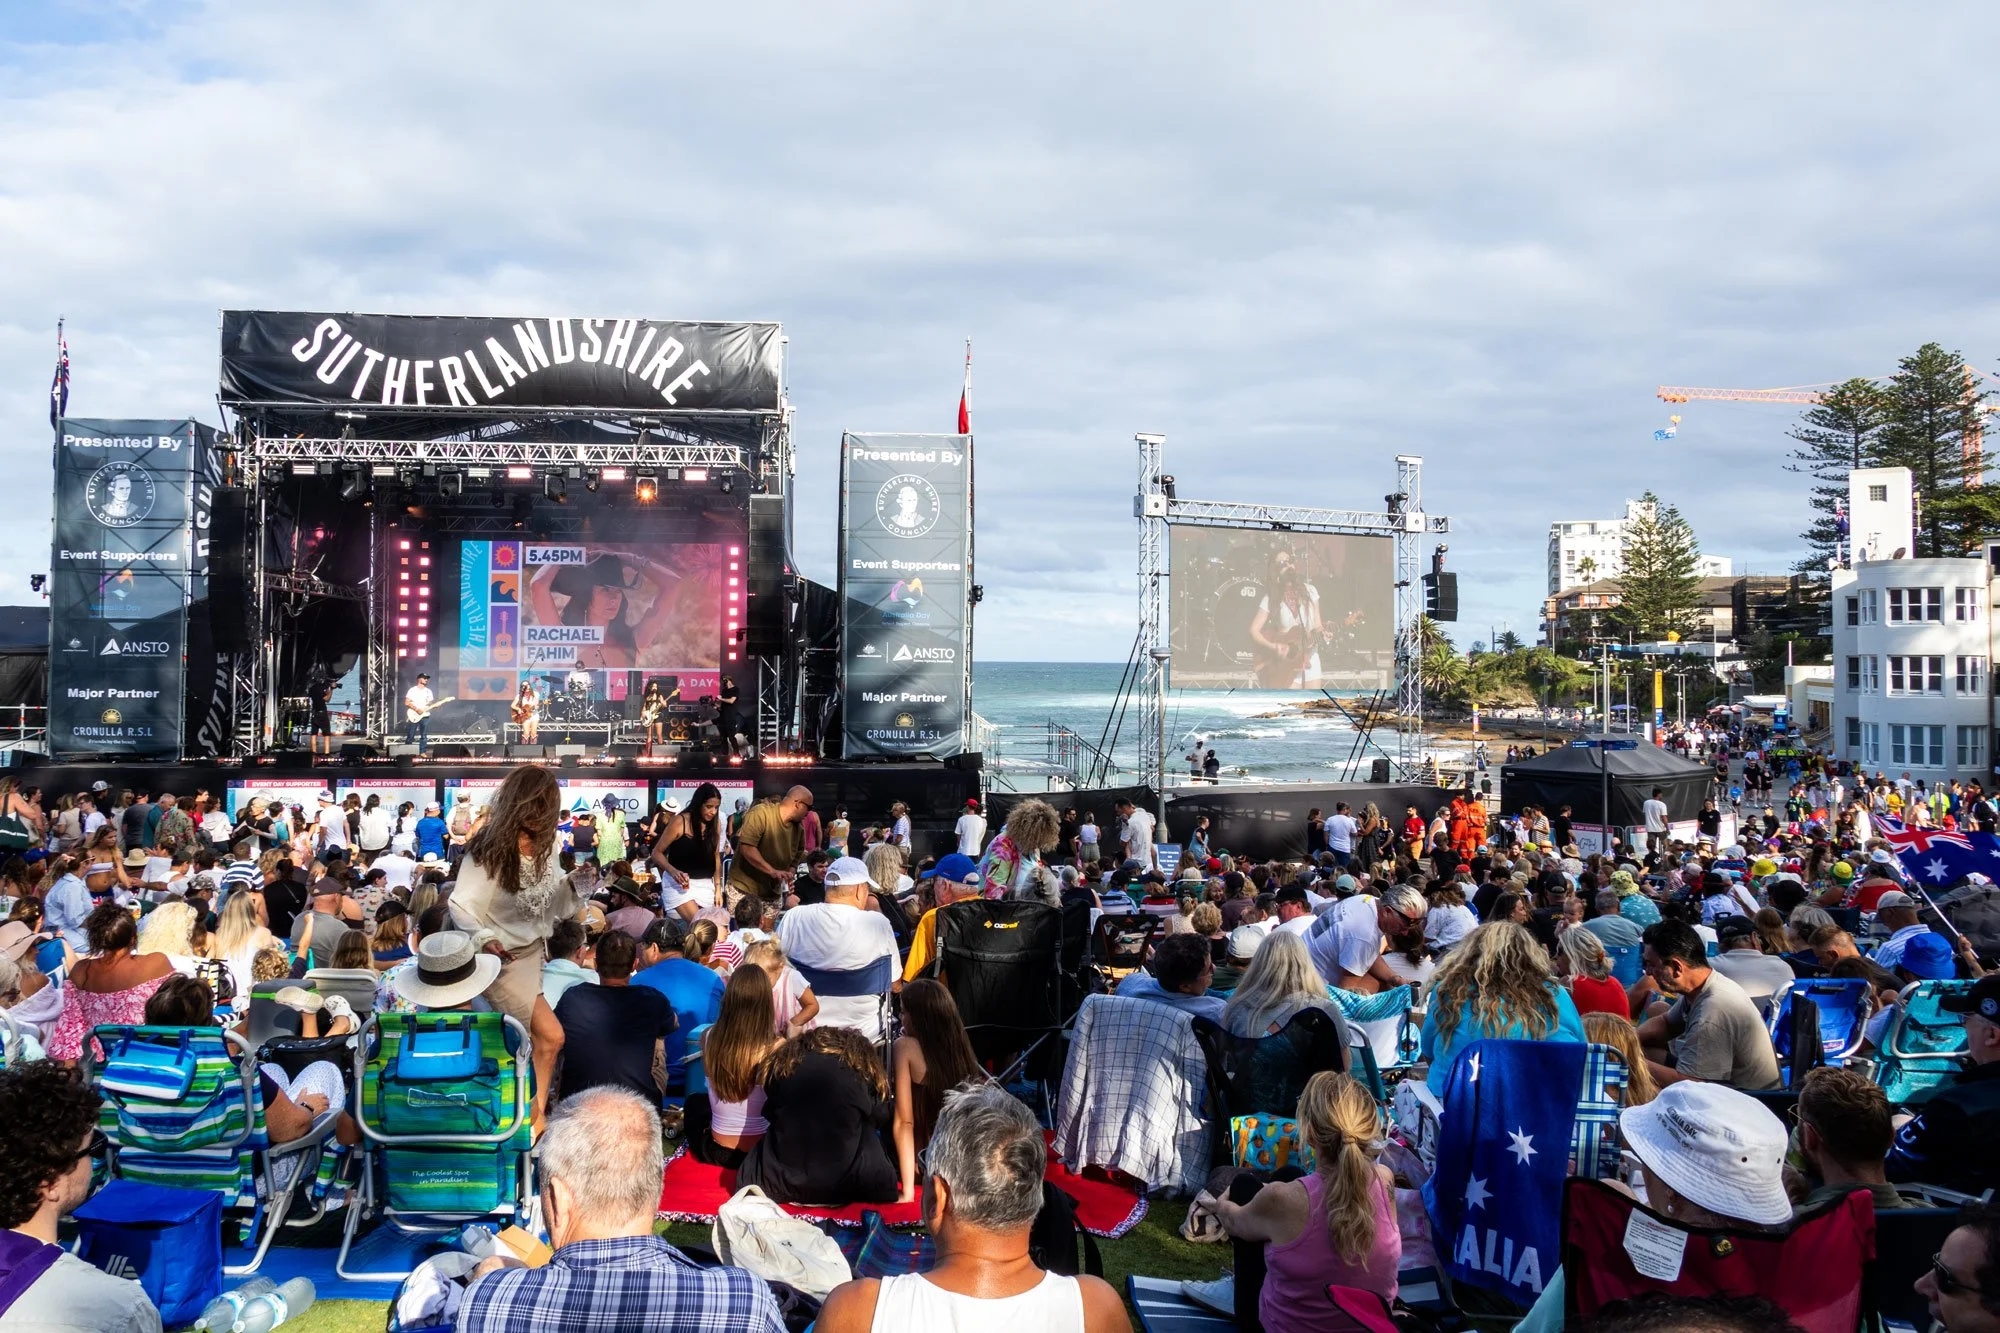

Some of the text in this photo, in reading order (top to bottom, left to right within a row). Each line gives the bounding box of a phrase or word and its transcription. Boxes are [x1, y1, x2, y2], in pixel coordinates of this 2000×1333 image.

[292, 318, 710, 405] SUTHERLANDSHIRE
[63, 434, 182, 451] Presented By
[853, 448, 963, 466] Presented By
[88, 464, 153, 500] SUTHERLAND SHIRE
[879, 477, 938, 512] SUTHERLAND SHIRE
[98, 512, 141, 525] COUNCIL
[888, 524, 928, 536] COUNCIL
[60, 550, 178, 564] Event Supporters
[529, 549, 583, 562] 5.45PM
[853, 559, 961, 572] Event Supporters
[527, 628, 600, 641] RACHAEL
[122, 641, 170, 653] ANSTO
[527, 647, 575, 660] FAHIM
[914, 647, 955, 660] ANSTO
[690, 679, 714, 687] DAY
[67, 688, 160, 699] Major Partner
[862, 692, 947, 703] Major Partner
[73, 727, 123, 736] CRONULLA
[867, 729, 915, 739] CRONULLA
[1454, 1224, 1543, 1294] ALIA
